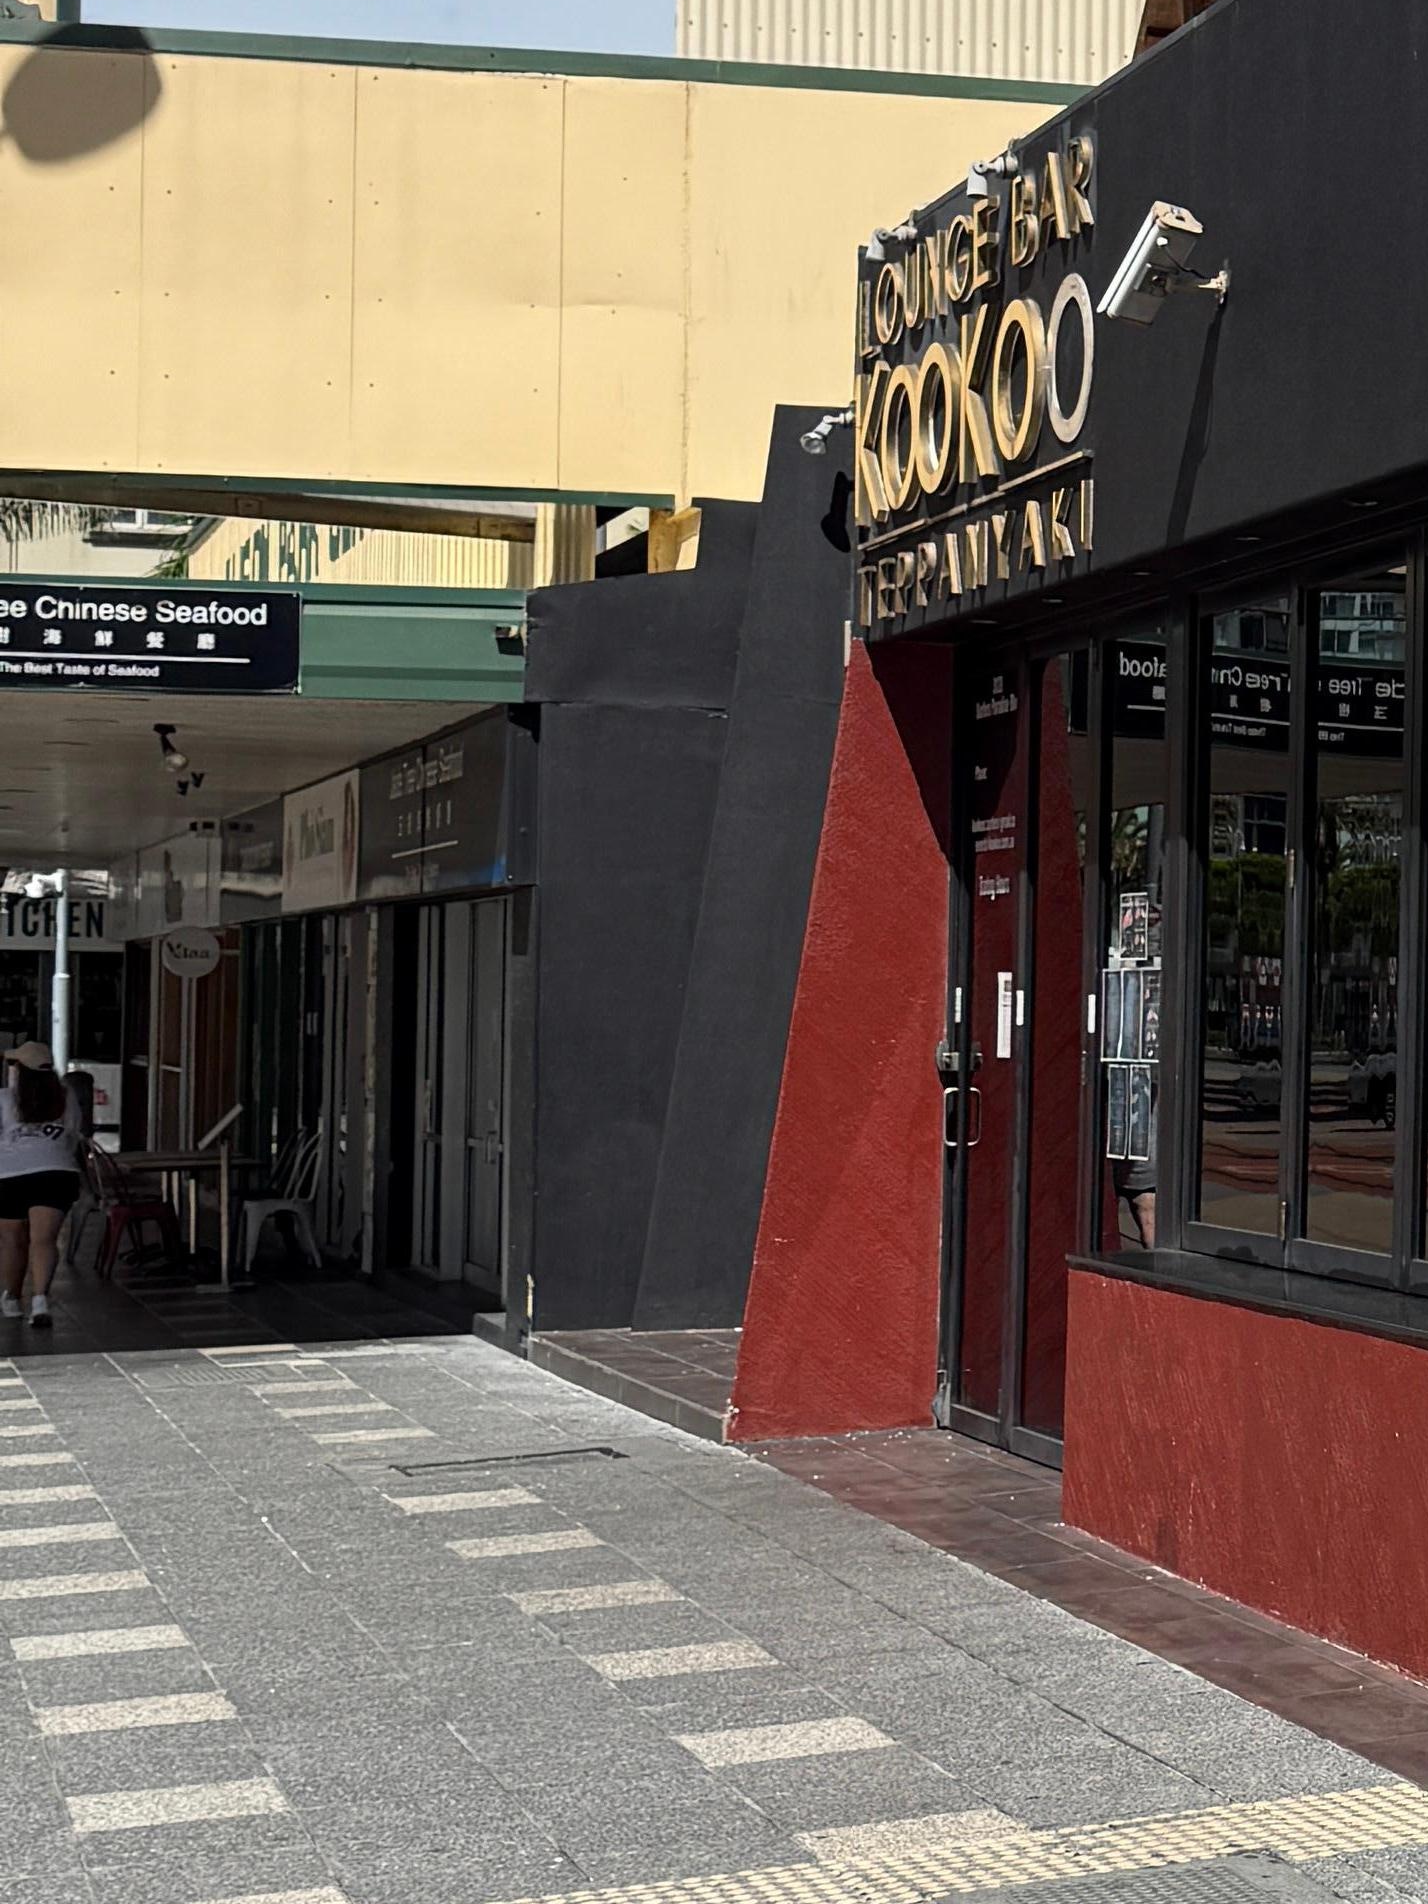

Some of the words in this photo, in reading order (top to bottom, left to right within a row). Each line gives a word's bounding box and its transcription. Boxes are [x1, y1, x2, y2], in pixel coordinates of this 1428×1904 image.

[859, 197, 1000, 358] LOUNGE
[1011, 136, 1094, 267] BAR
[855, 272, 1094, 526] KOOKOO
[35, 595, 148, 622] Chinese
[155, 599, 268, 625] Seafood
[857, 479, 1094, 627] TEPPANYAKI
[24, 661, 53, 675] Best
[56, 662, 91, 676] Taste
[93, 663, 107, 676] of
[108, 663, 160, 678] Seafood
